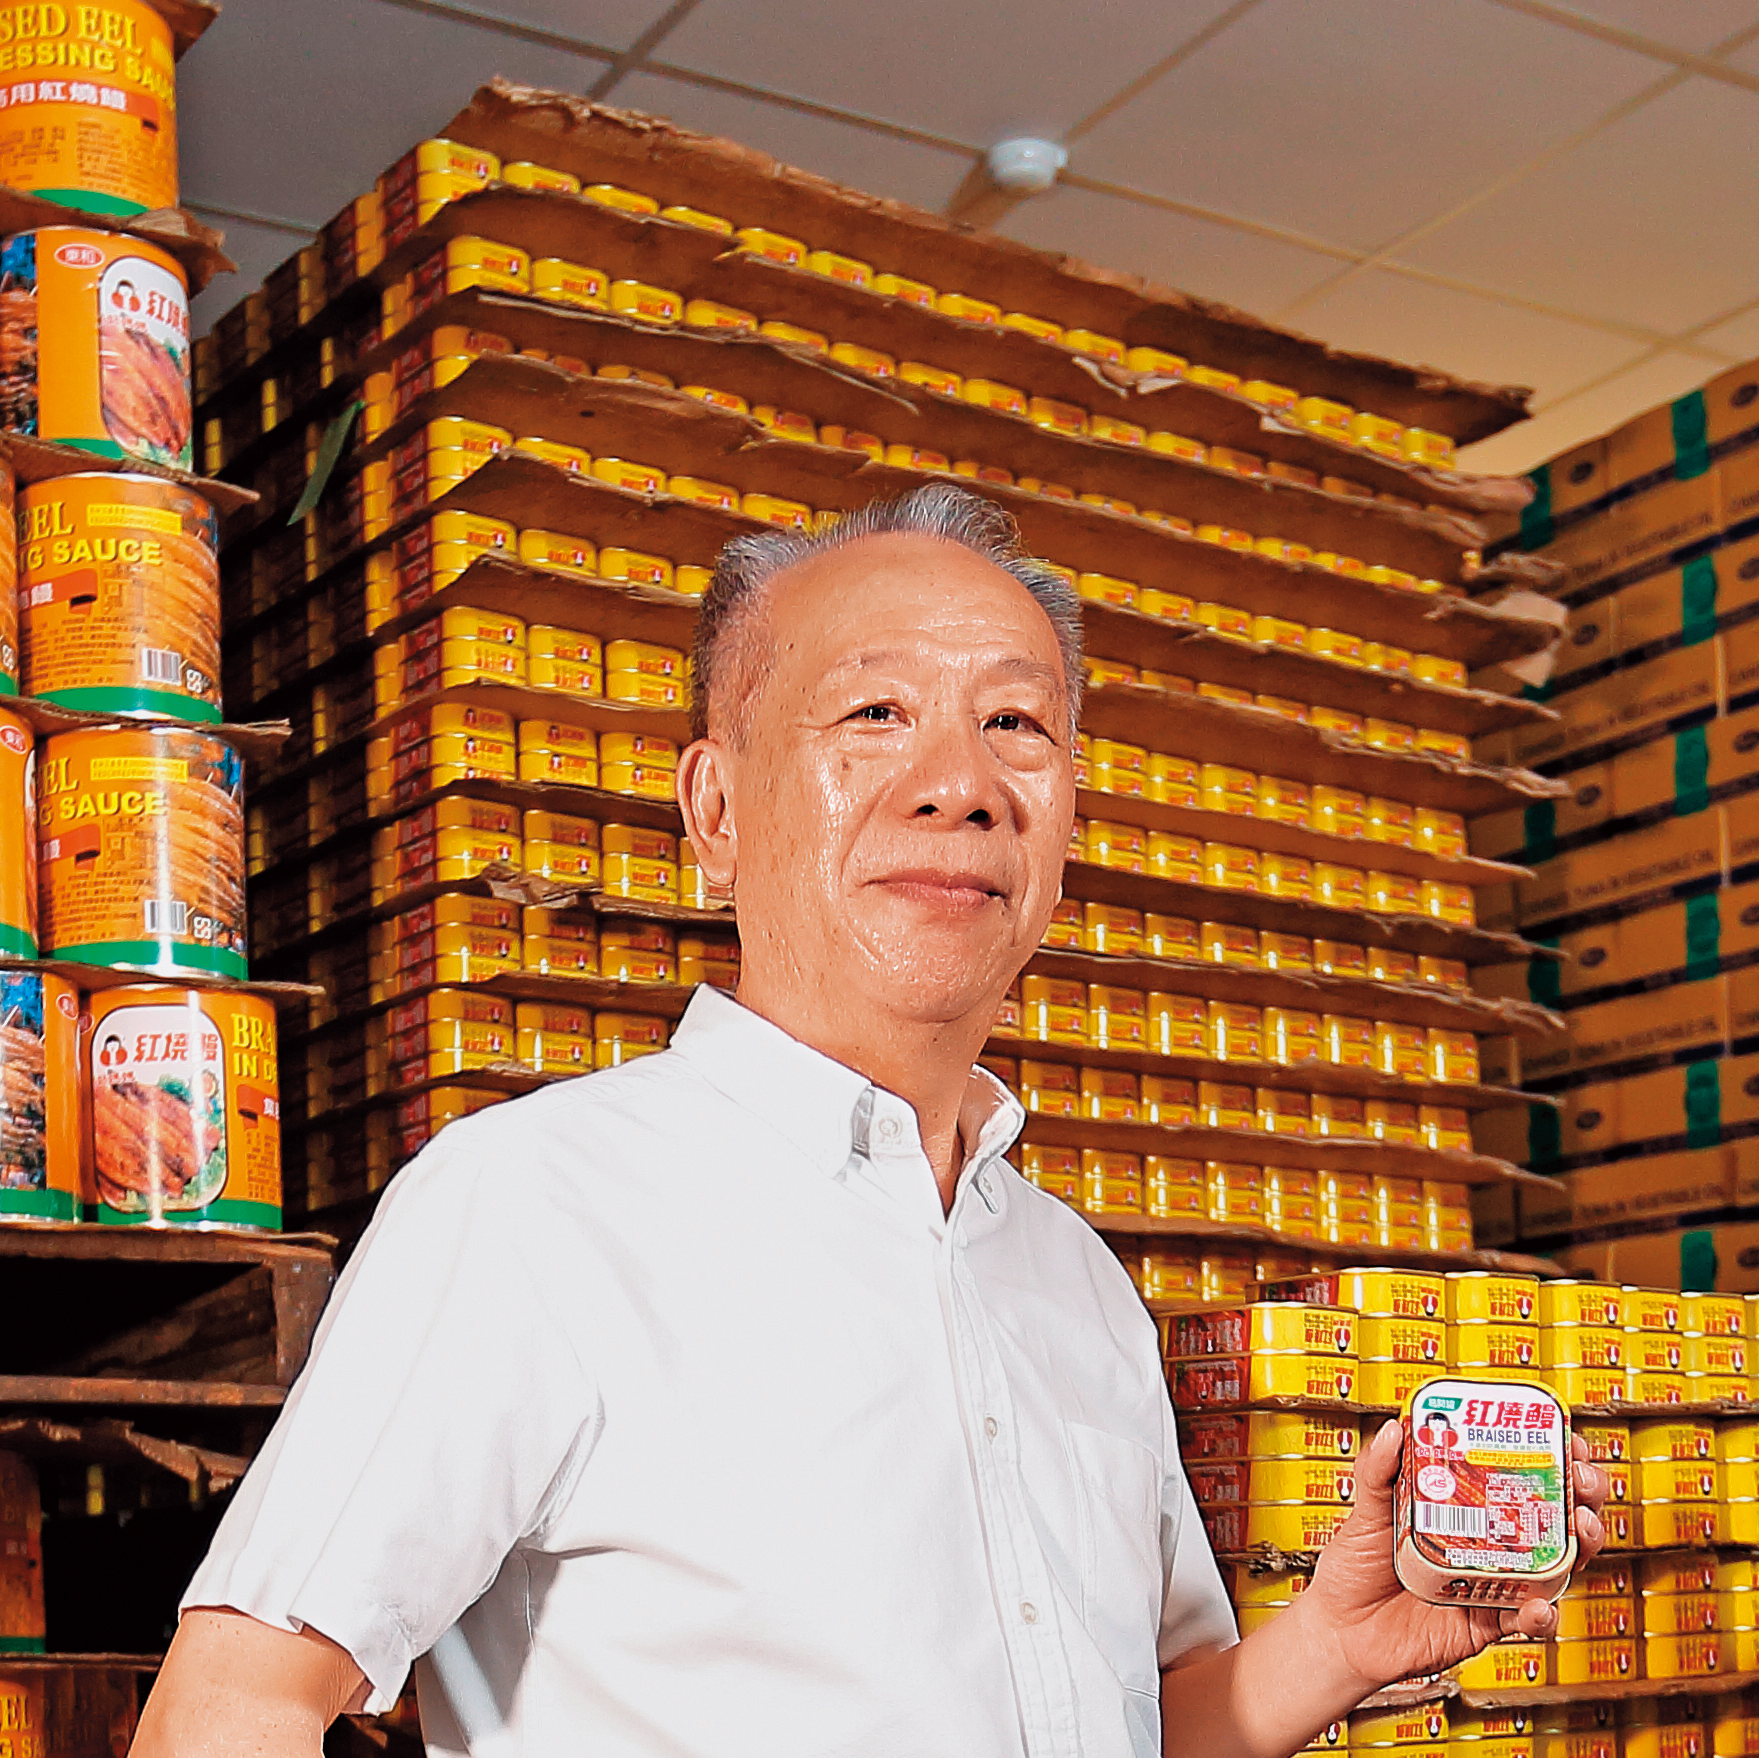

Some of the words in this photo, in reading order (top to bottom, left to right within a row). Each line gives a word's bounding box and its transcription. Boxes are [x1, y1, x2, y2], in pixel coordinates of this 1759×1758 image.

[78, 5, 144, 52] EEL
[51, 538, 162, 566] SAUCE
[58, 791, 167, 820] SAUCE
[132, 1031, 218, 1064] 紅燒鰻
[232, 1053, 257, 1079] IN
[1463, 1399, 1556, 1430] 紅燒鰻
[1468, 1428, 1521, 1444] BRAISED
[1527, 1430, 1551, 1444] EEL
